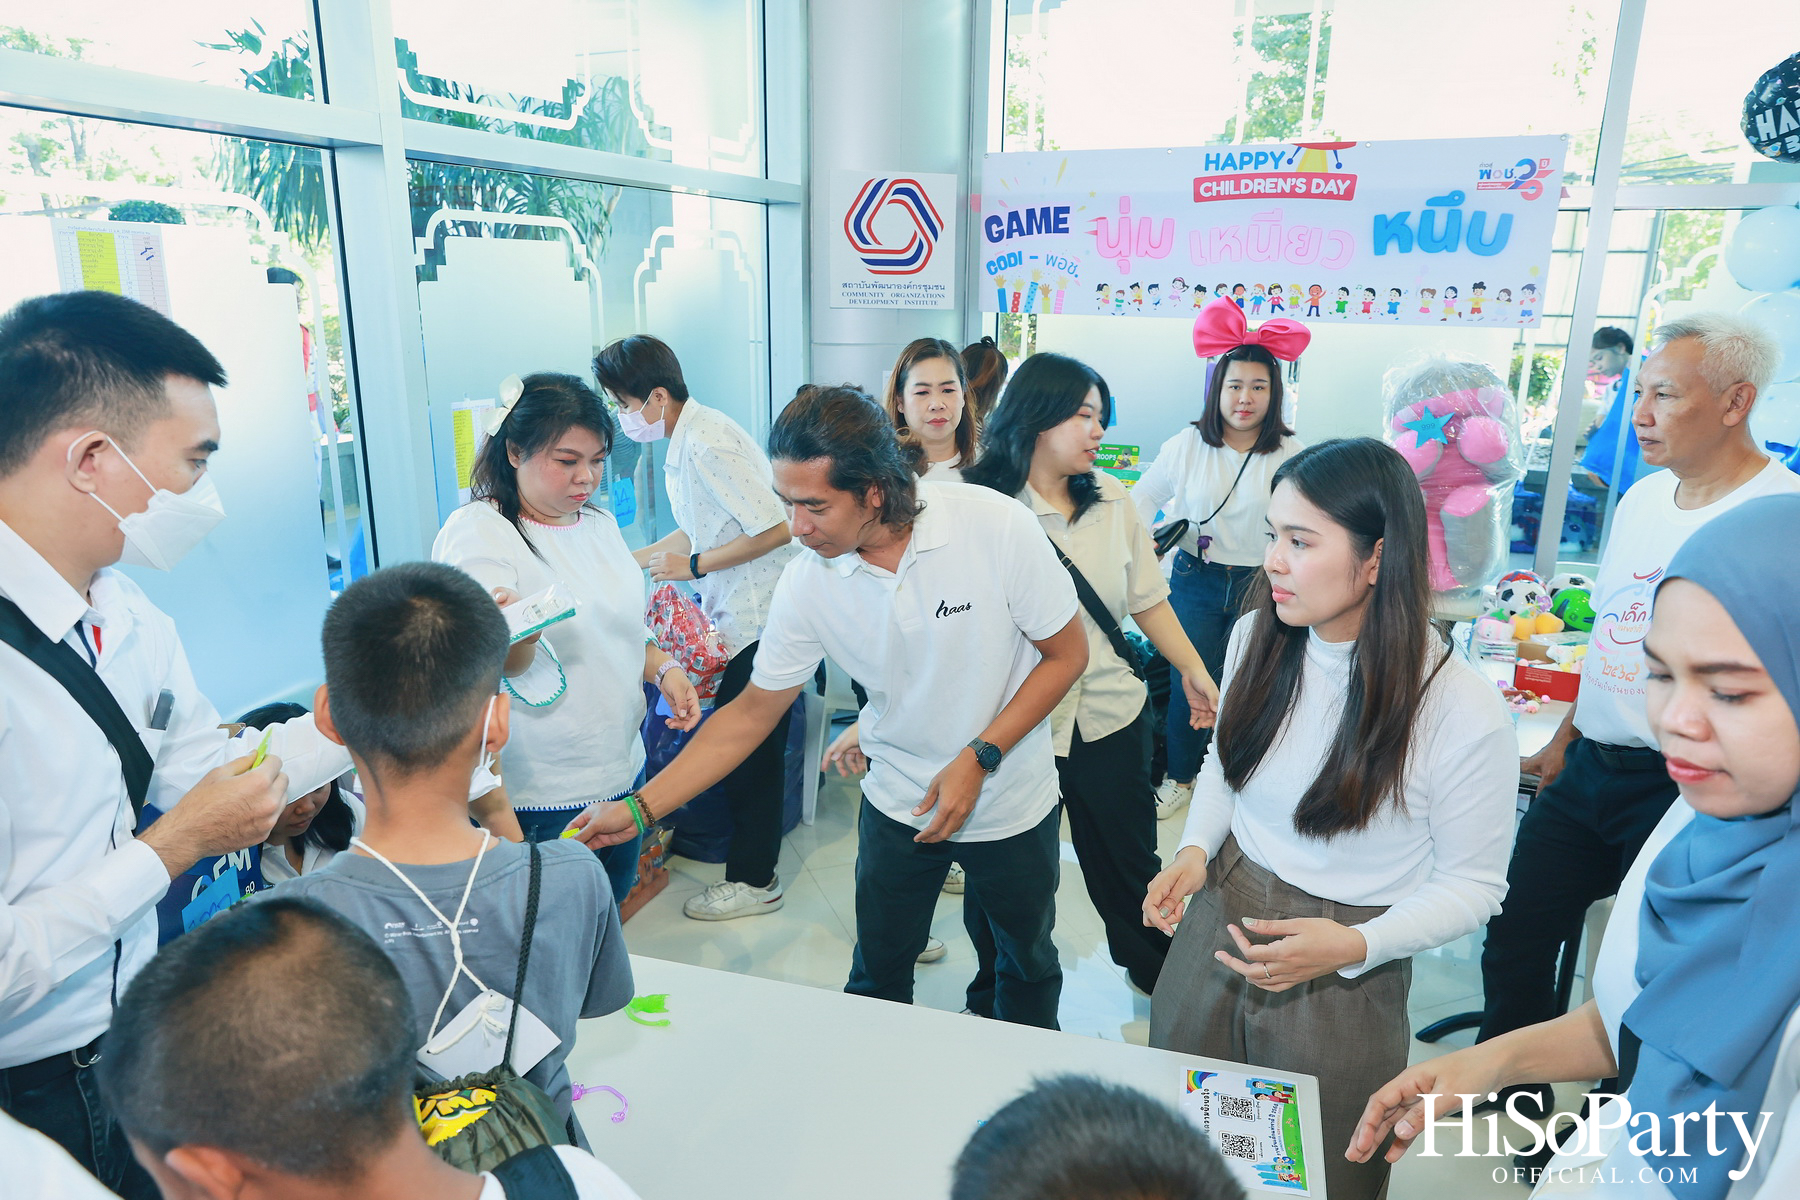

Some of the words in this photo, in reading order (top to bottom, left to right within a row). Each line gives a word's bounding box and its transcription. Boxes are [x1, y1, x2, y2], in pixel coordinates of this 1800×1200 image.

[1755, 98, 1800, 142] HA
[1204, 150, 1286, 171] HAPPY
[1199, 177, 1307, 197] CHILDREN'S
[1311, 177, 1351, 195] DAY
[984, 205, 1071, 244] GAME
[1096, 195, 1175, 275] นุ่ม
[1188, 207, 1355, 271] เหนียว
[1373, 189, 1514, 256] หนึบ
[986, 250, 1023, 276] CODI
[1045, 253, 1079, 279] พอช.
[841, 280, 946, 292] สถาบันพัฒนาองค์กรชุมชน
[935, 599, 972, 619] haas
[1620, 602, 1647, 623] เด็ก
